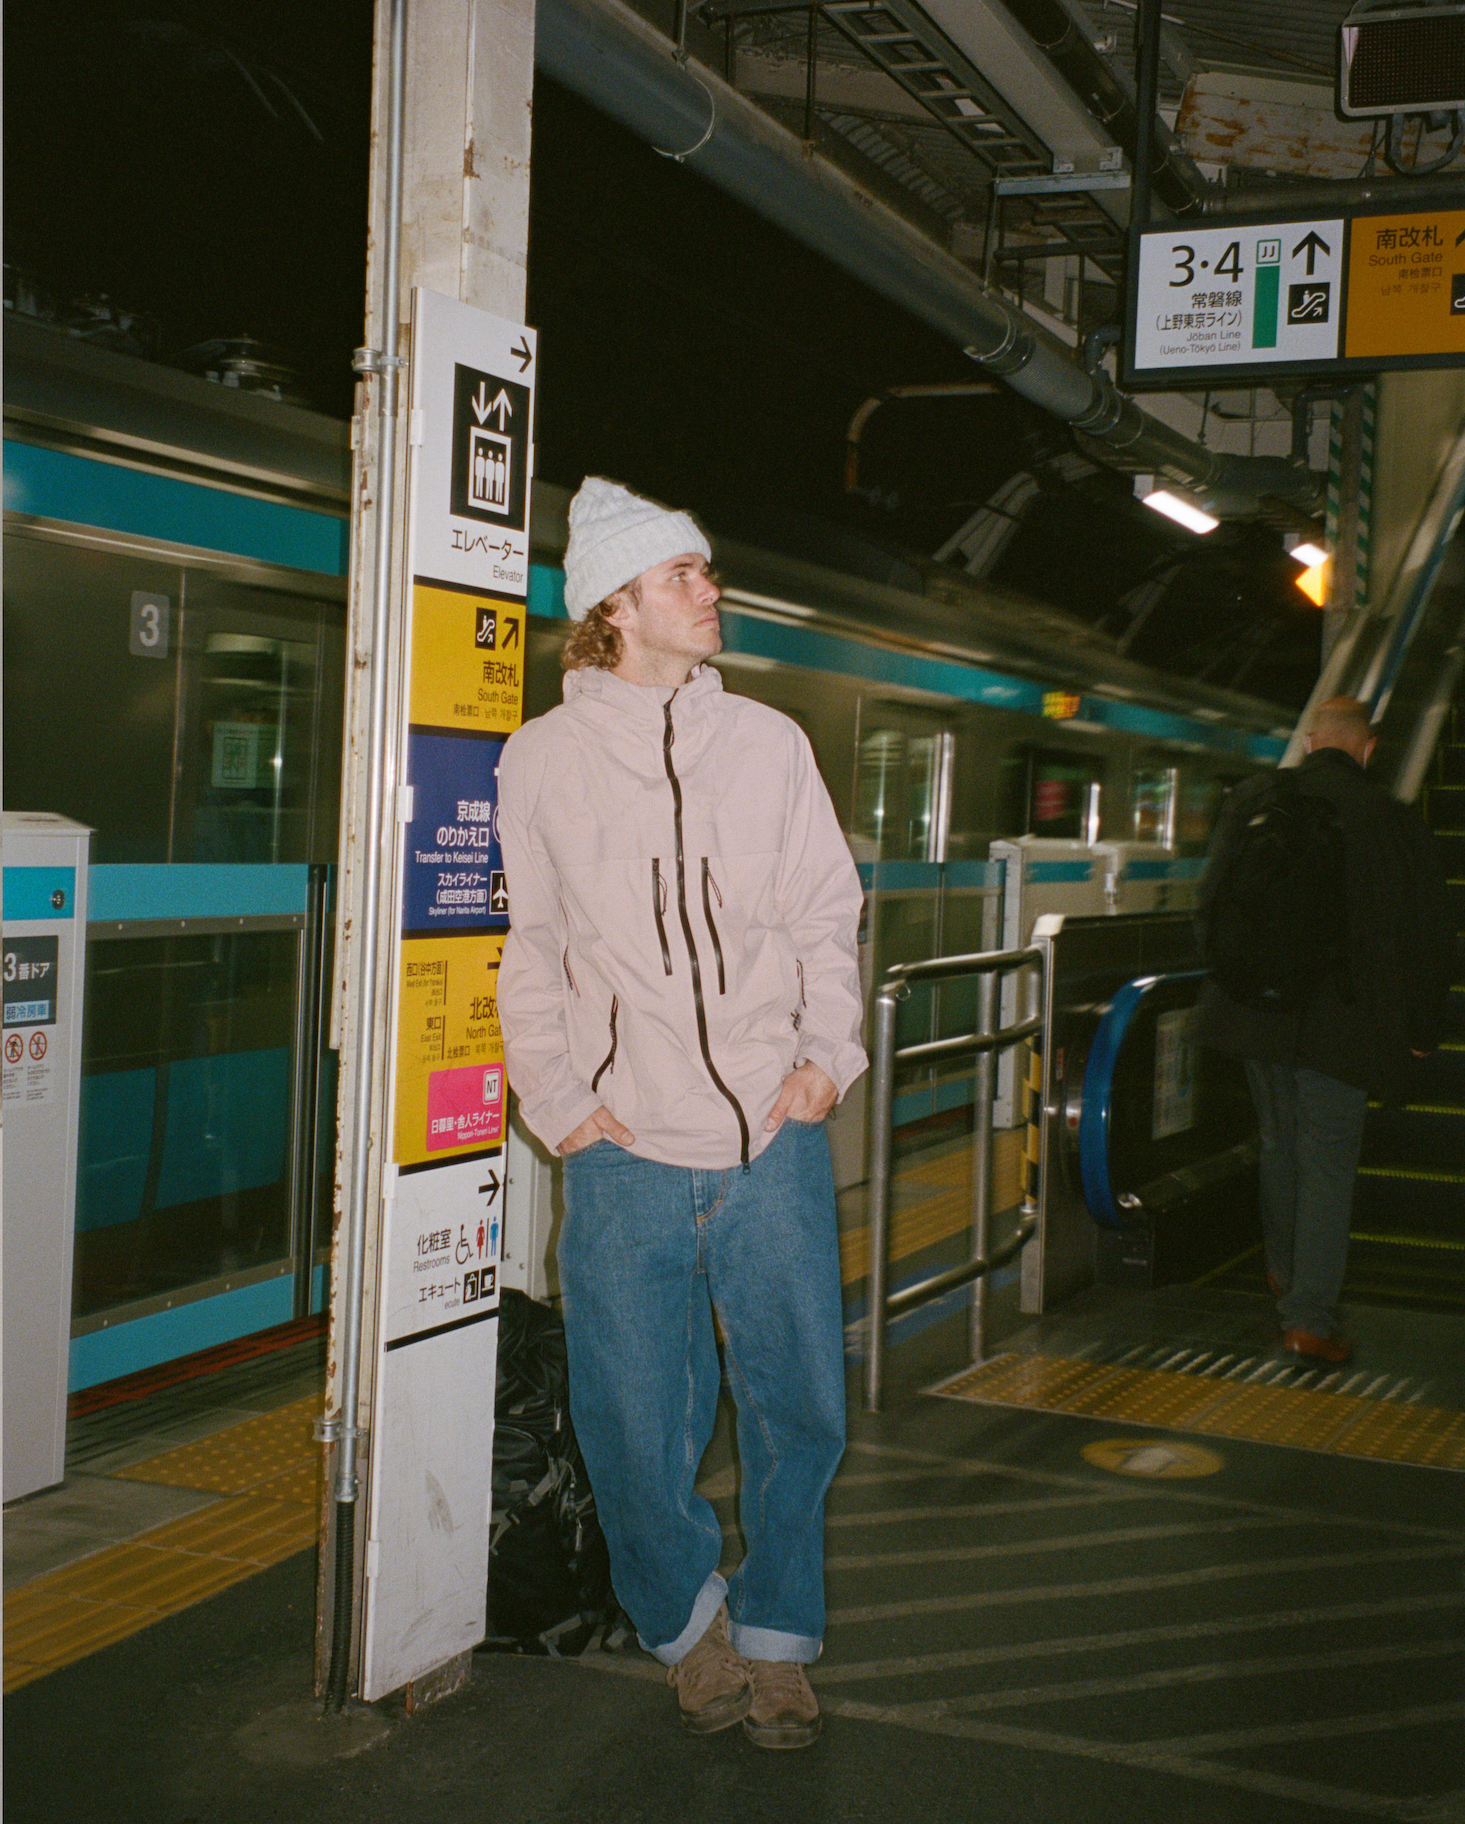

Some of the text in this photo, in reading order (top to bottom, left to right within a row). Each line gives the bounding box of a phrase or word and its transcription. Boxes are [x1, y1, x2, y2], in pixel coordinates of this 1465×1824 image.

[1376, 225, 1443, 250] 南改札
[1262, 246, 1275, 258] JJ
[1368, 251, 1443, 267] South Gate
[1191, 290, 1242, 309] 常磐線
[1220, 330, 1241, 340] Line
[1218, 341, 1241, 352] Line)
[451, 529, 524, 561] エレベーター
[493, 565, 523, 583] Elevator
[139, 603, 160, 647] 3
[483, 660, 520, 687] 南改札
[477, 688, 519, 705] South Gate
[457, 800, 490, 822] 京成線
[436, 826, 490, 848] のりかえ口
[415, 851, 489, 863] Transfer to Keisei Line
[438, 872, 488, 887] スカイライナー
[4, 952, 51, 982] 3番ドア
[6, 1004, 47, 1020] 弱冷房車
[426, 1016, 441, 1031] 東口
[466, 1024, 502, 1040] North Gat
[486, 1079, 498, 1094] NT
[417, 1228, 451, 1256] 化粧室
[413, 1255, 450, 1273] Restrooms
[419, 1277, 461, 1303] エキュート
